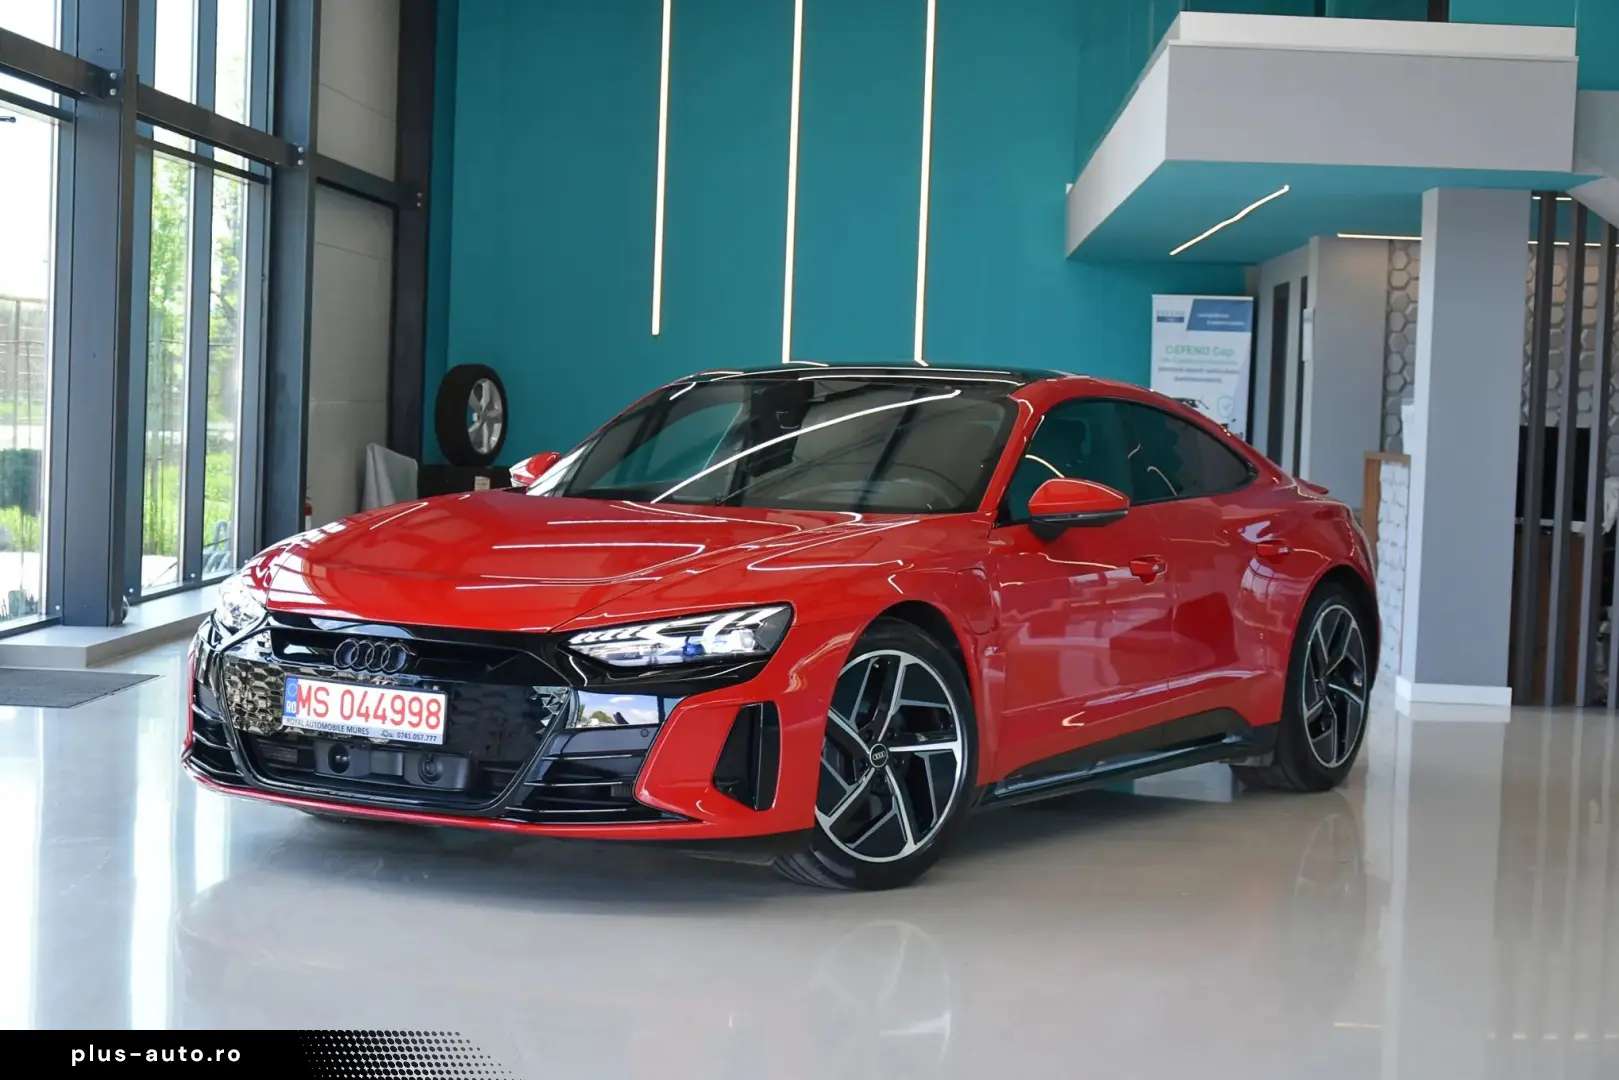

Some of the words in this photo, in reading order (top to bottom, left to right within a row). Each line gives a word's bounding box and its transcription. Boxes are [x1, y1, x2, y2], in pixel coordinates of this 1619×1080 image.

[286, 700, 297, 714] RO
[296, 684, 330, 718] MS
[340, 689, 442, 730] 044998
[286, 717, 304, 727] ROYAL
[305, 719, 345, 733] AUTOMOBILE
[396, 731, 437, 743] 0741.057.777
